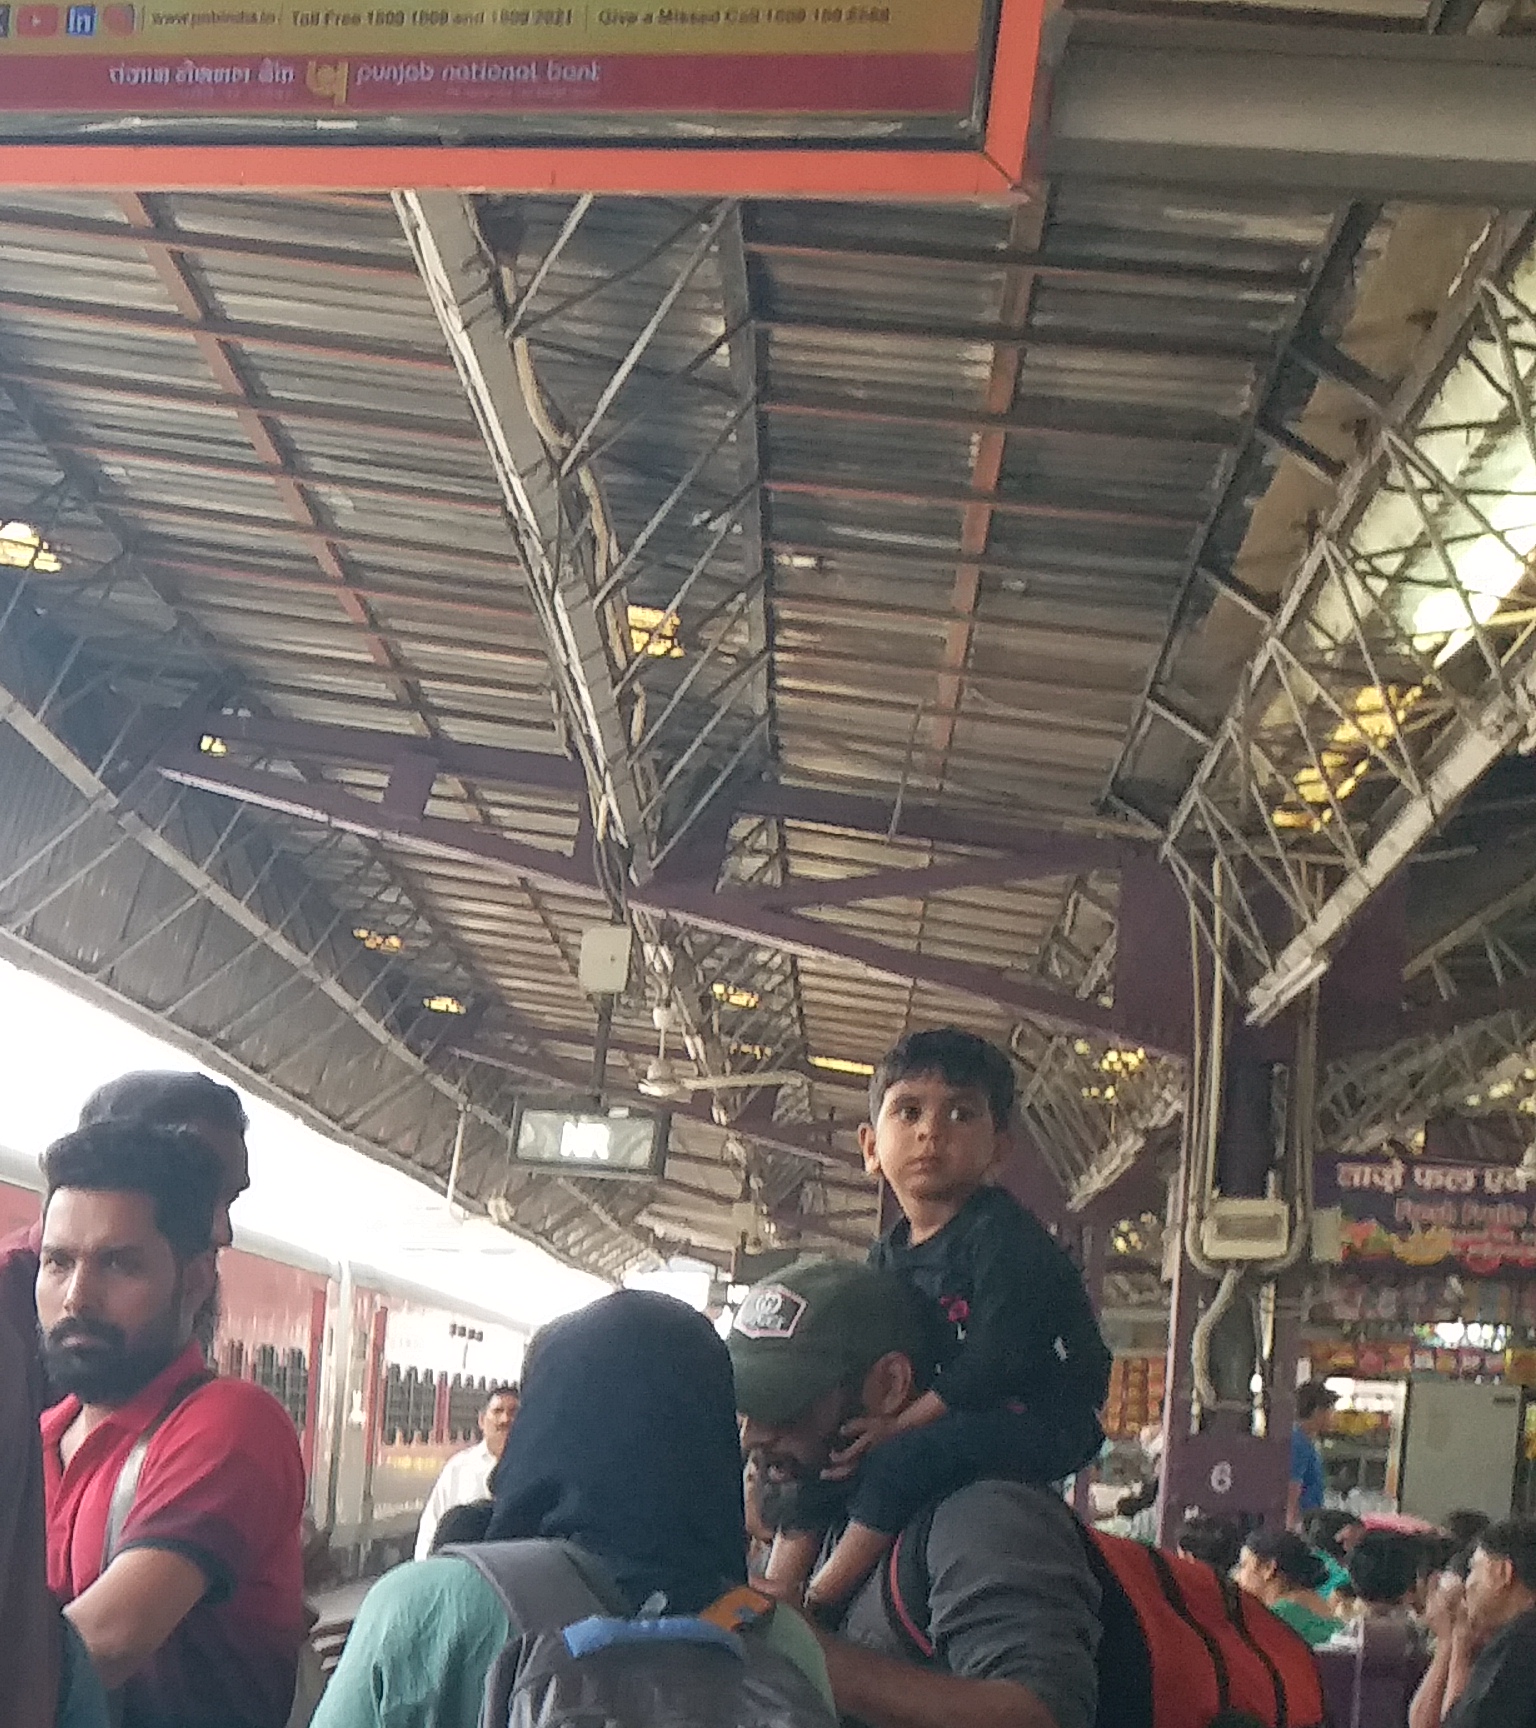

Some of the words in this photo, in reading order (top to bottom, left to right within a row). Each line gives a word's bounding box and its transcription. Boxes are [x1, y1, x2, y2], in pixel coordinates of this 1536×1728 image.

[356, 60, 435, 85] punjab
[441, 61, 538, 83] national
[546, 60, 601, 83] bank
